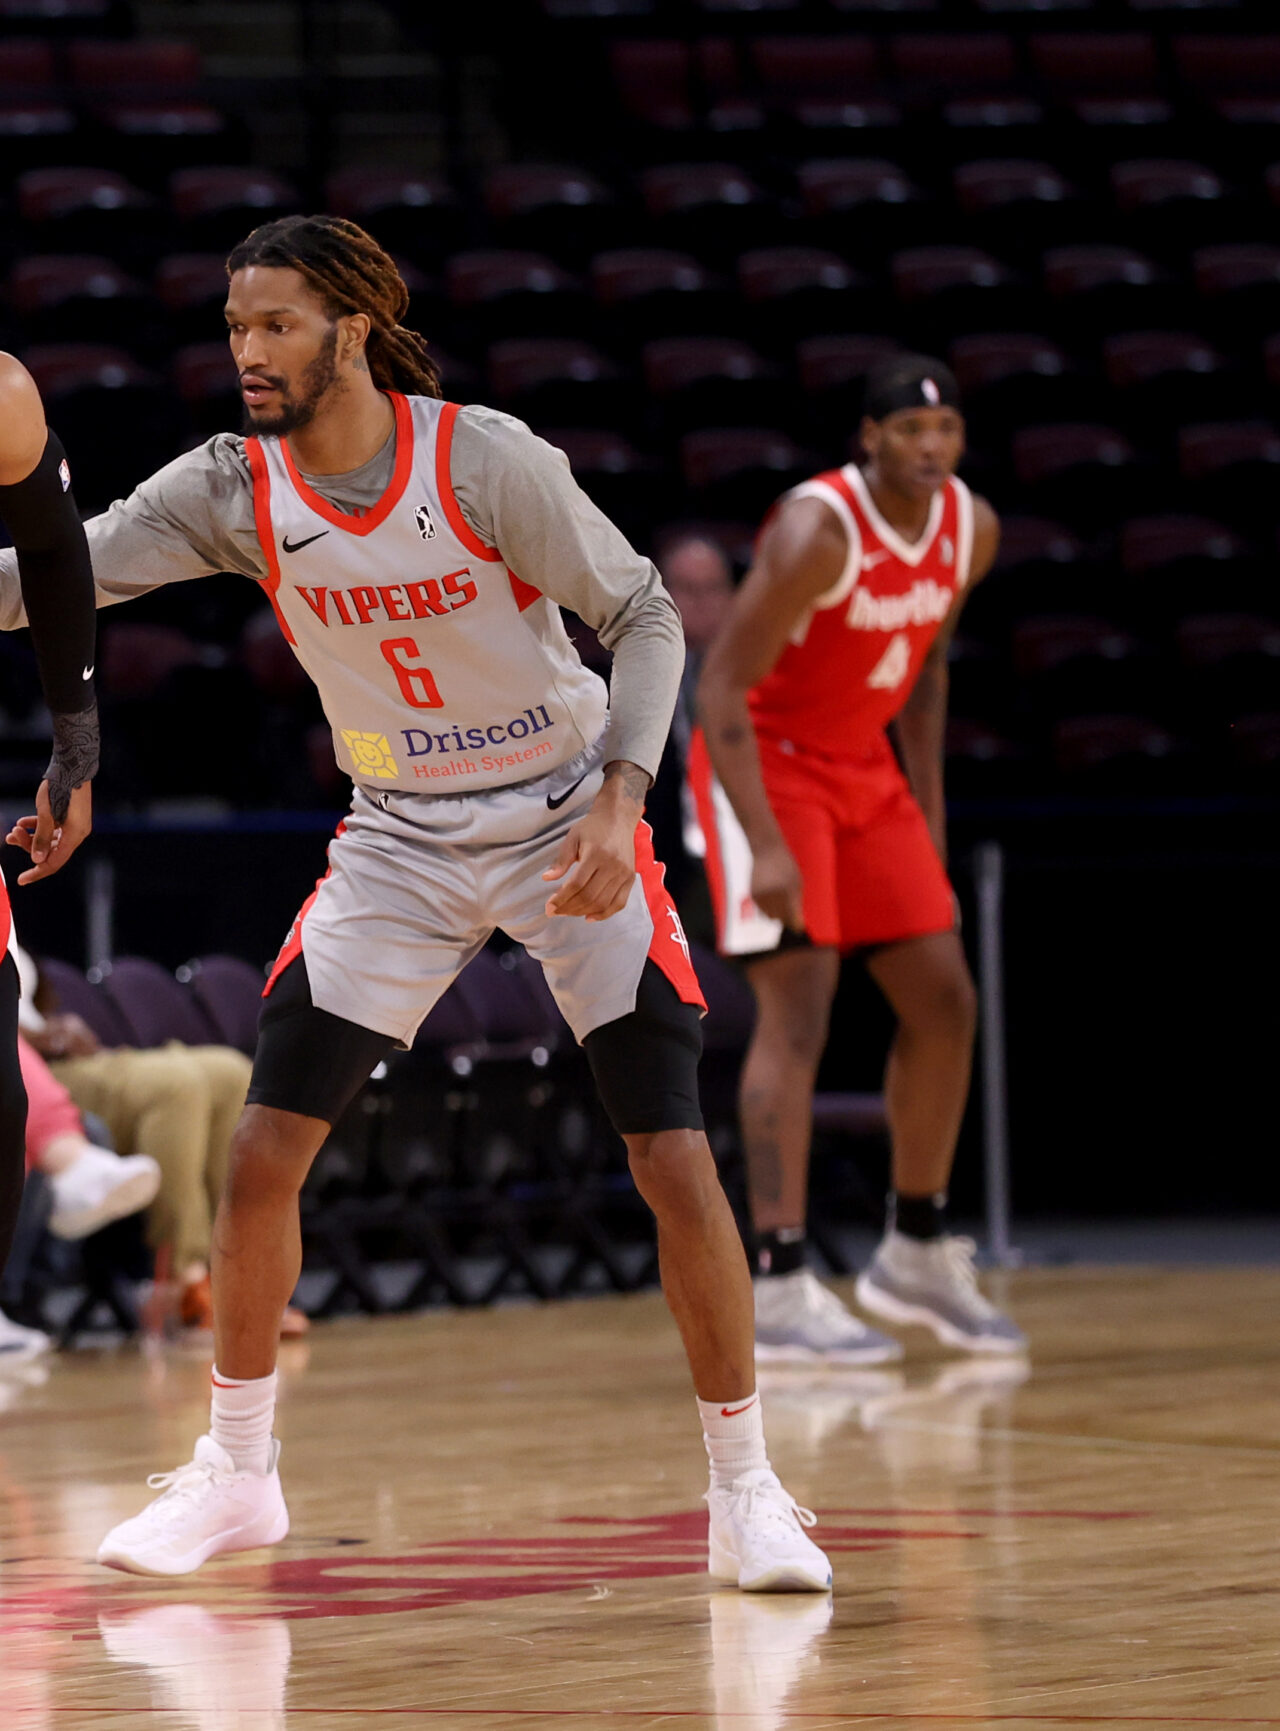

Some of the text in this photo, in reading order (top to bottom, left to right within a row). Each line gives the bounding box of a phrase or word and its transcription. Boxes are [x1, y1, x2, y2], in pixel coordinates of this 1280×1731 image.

[294, 568, 478, 627] VIPERS
[380, 637, 444, 708] 6
[867, 633, 911, 690] 4
[400, 704, 554, 757] Driscoll
[412, 741, 554, 779] Health System
